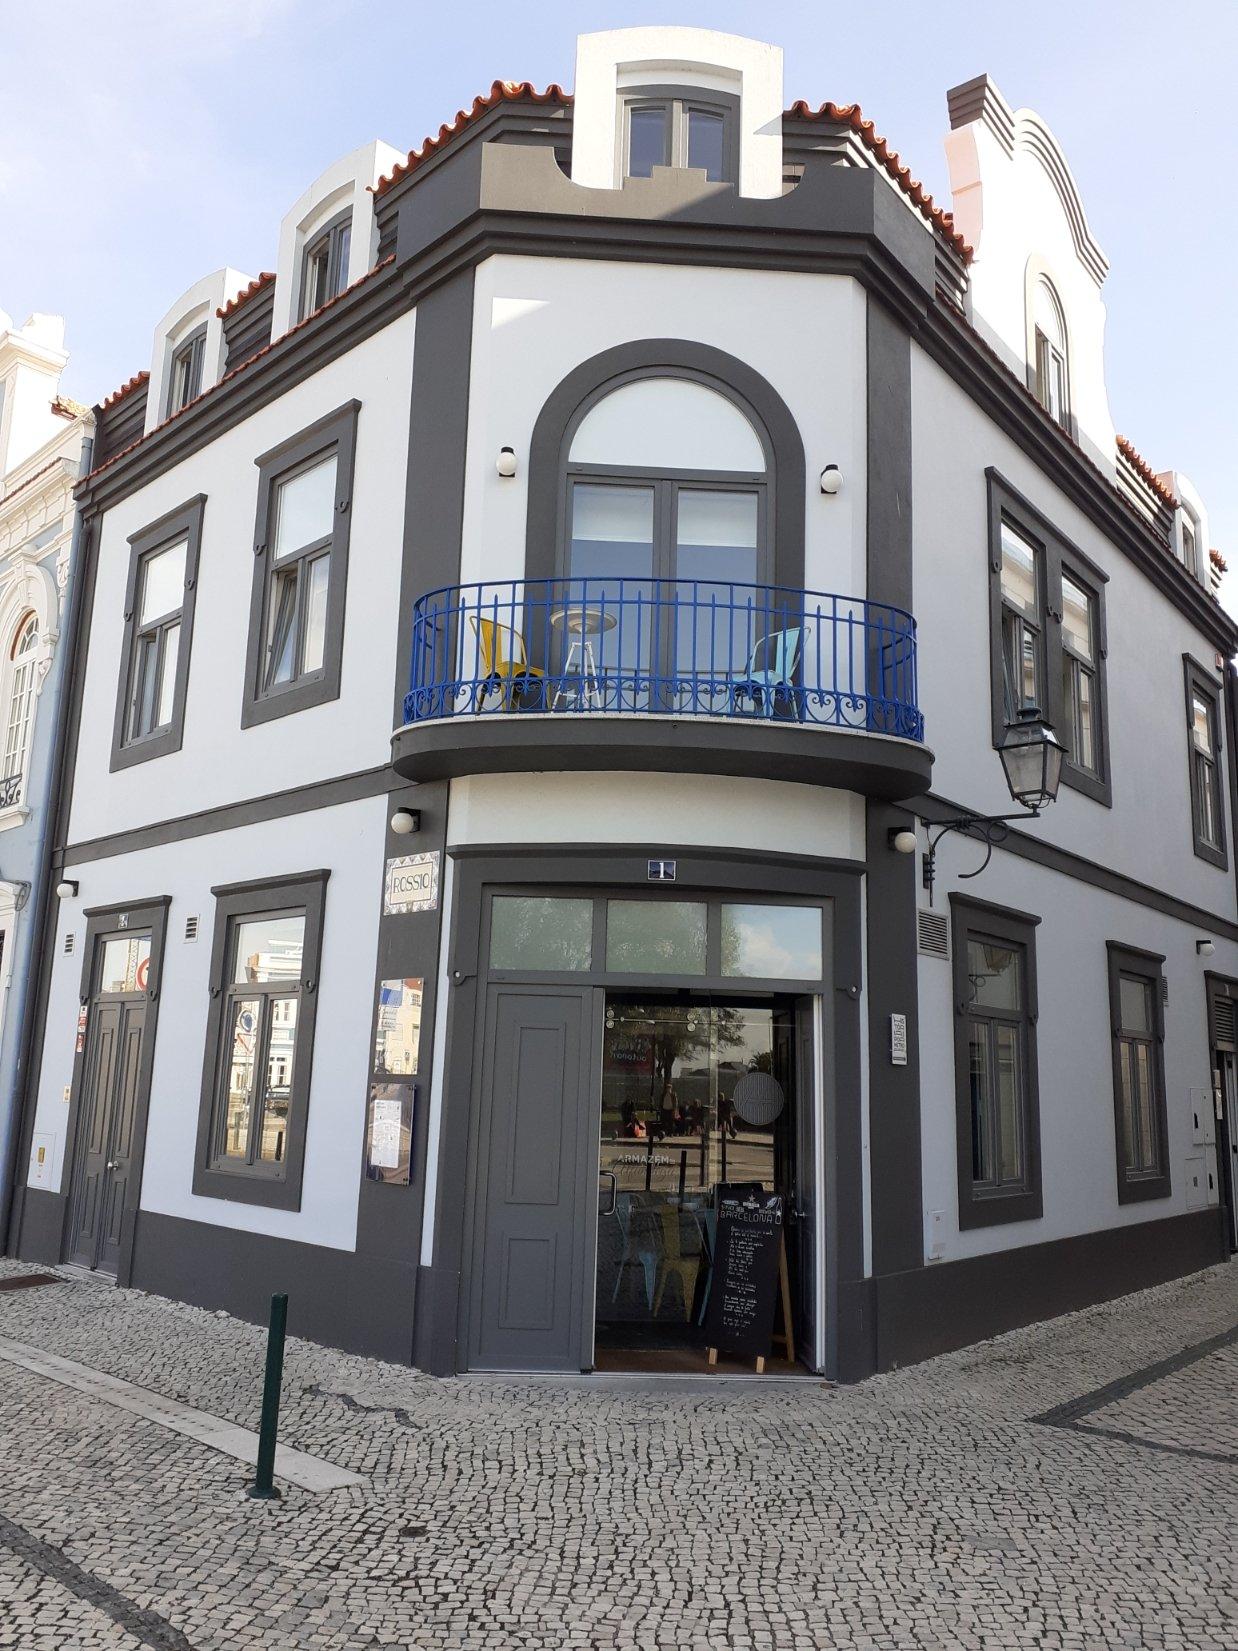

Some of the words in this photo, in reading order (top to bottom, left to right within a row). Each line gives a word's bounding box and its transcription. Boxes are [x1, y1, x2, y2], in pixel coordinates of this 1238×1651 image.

[659, 862, 665, 879] 1
[393, 873, 430, 893] ROSSIO
[720, 1210, 773, 1224] BARCELONA
